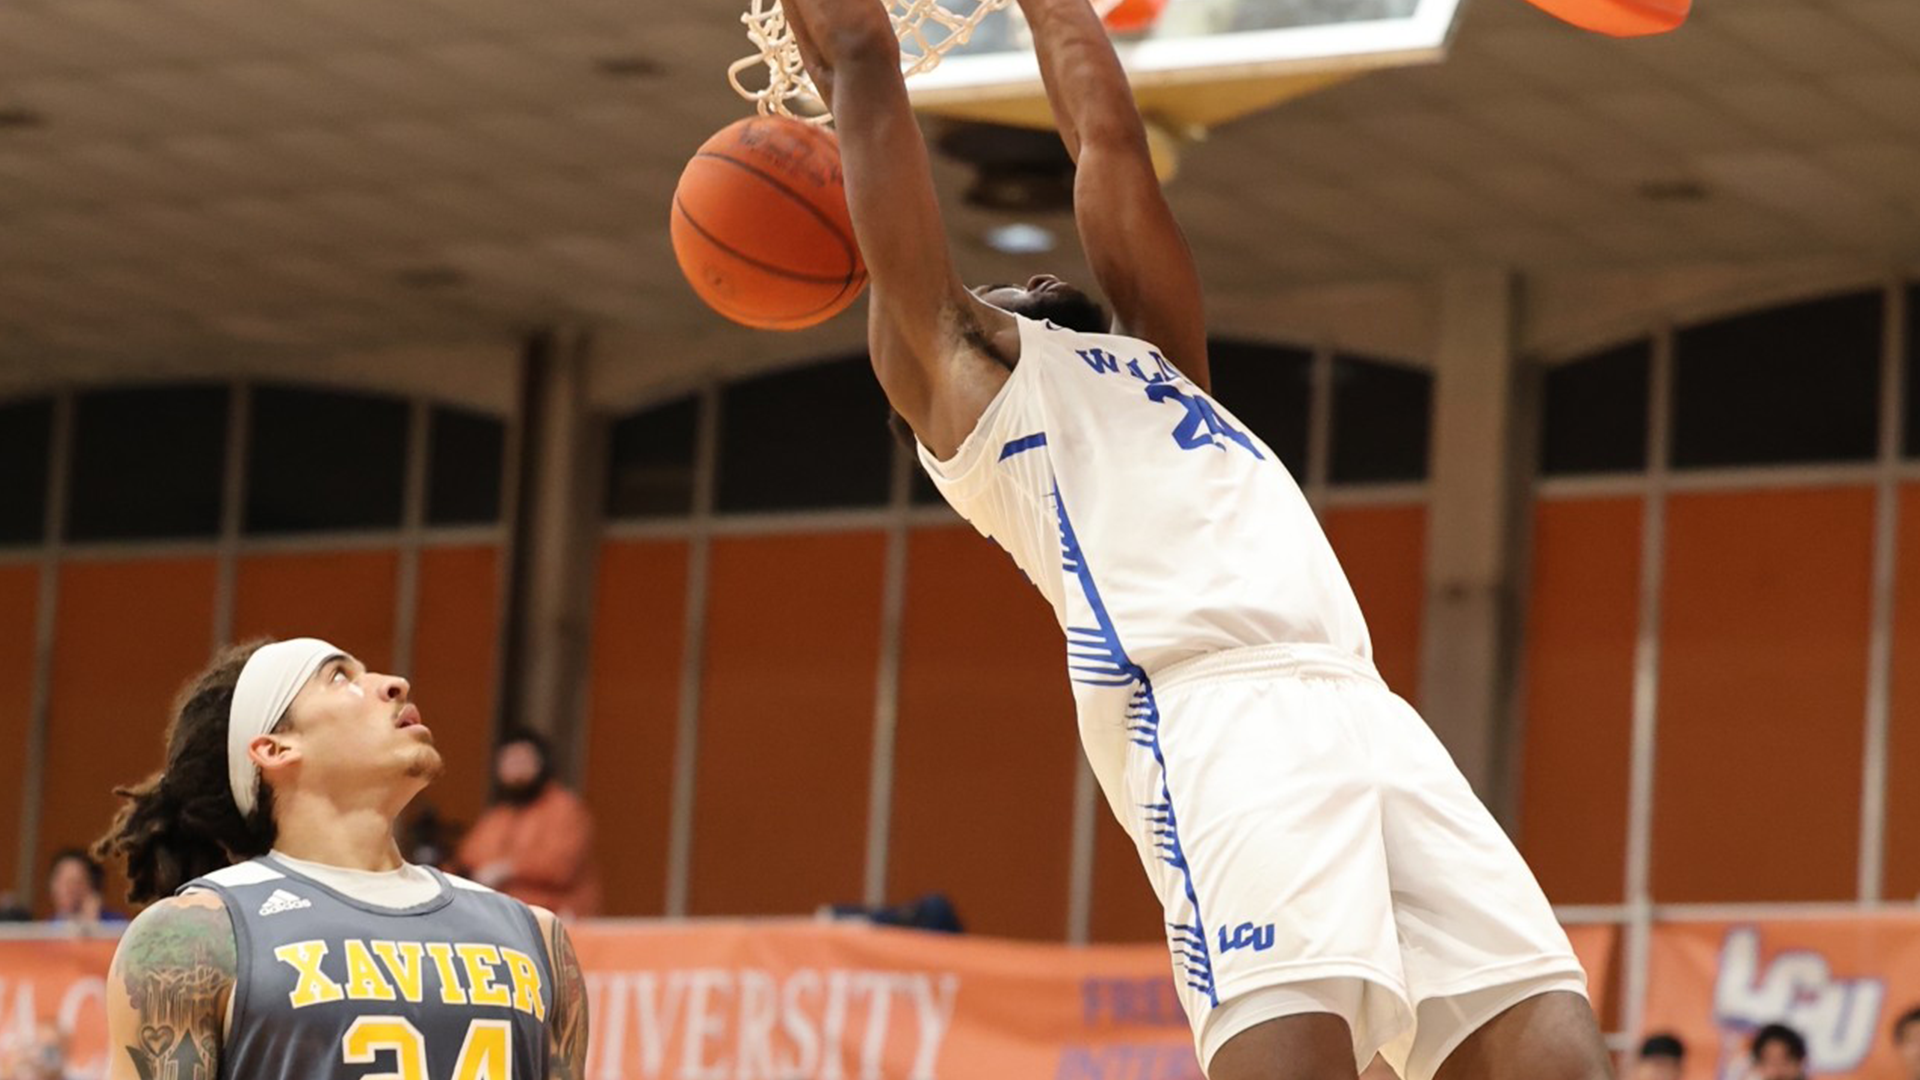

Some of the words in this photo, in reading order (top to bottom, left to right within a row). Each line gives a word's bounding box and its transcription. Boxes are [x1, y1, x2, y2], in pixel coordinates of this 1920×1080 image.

[259, 899, 312, 916] adidas
[1218, 922, 1275, 954] LCU
[274, 939, 546, 1023] XAVIER
[1714, 925, 1886, 1073] LCU
